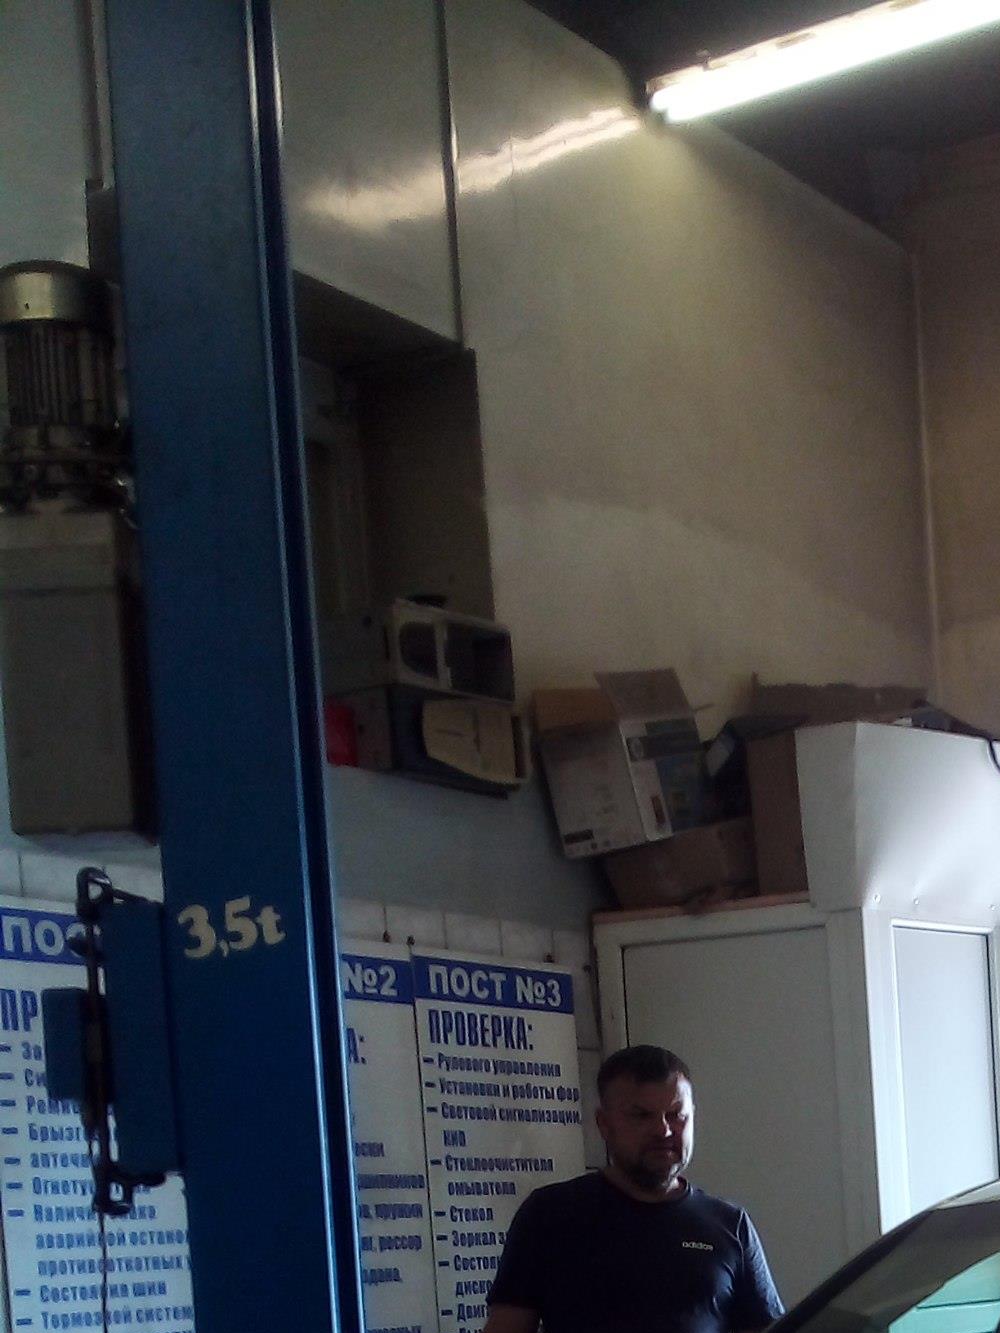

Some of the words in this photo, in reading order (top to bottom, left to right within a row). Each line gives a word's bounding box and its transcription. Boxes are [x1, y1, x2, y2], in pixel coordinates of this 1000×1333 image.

[0, 916, 102, 957] ПОС
[177, 894, 286, 958] 3,5t
[428, 964, 507, 1000] ПОСТ
[515, 976, 562, 1008] №3
[428, 1009, 534, 1050] ПРОВЕРКА:
[437, 1052, 490, 1073] Рулевого
[492, 1059, 561, 1078] управления
[512, 1083, 554, 1101] работы
[556, 1086, 579, 1102] фар
[441, 1102, 496, 1121] Световой
[450, 1206, 493, 1222] Стекол
